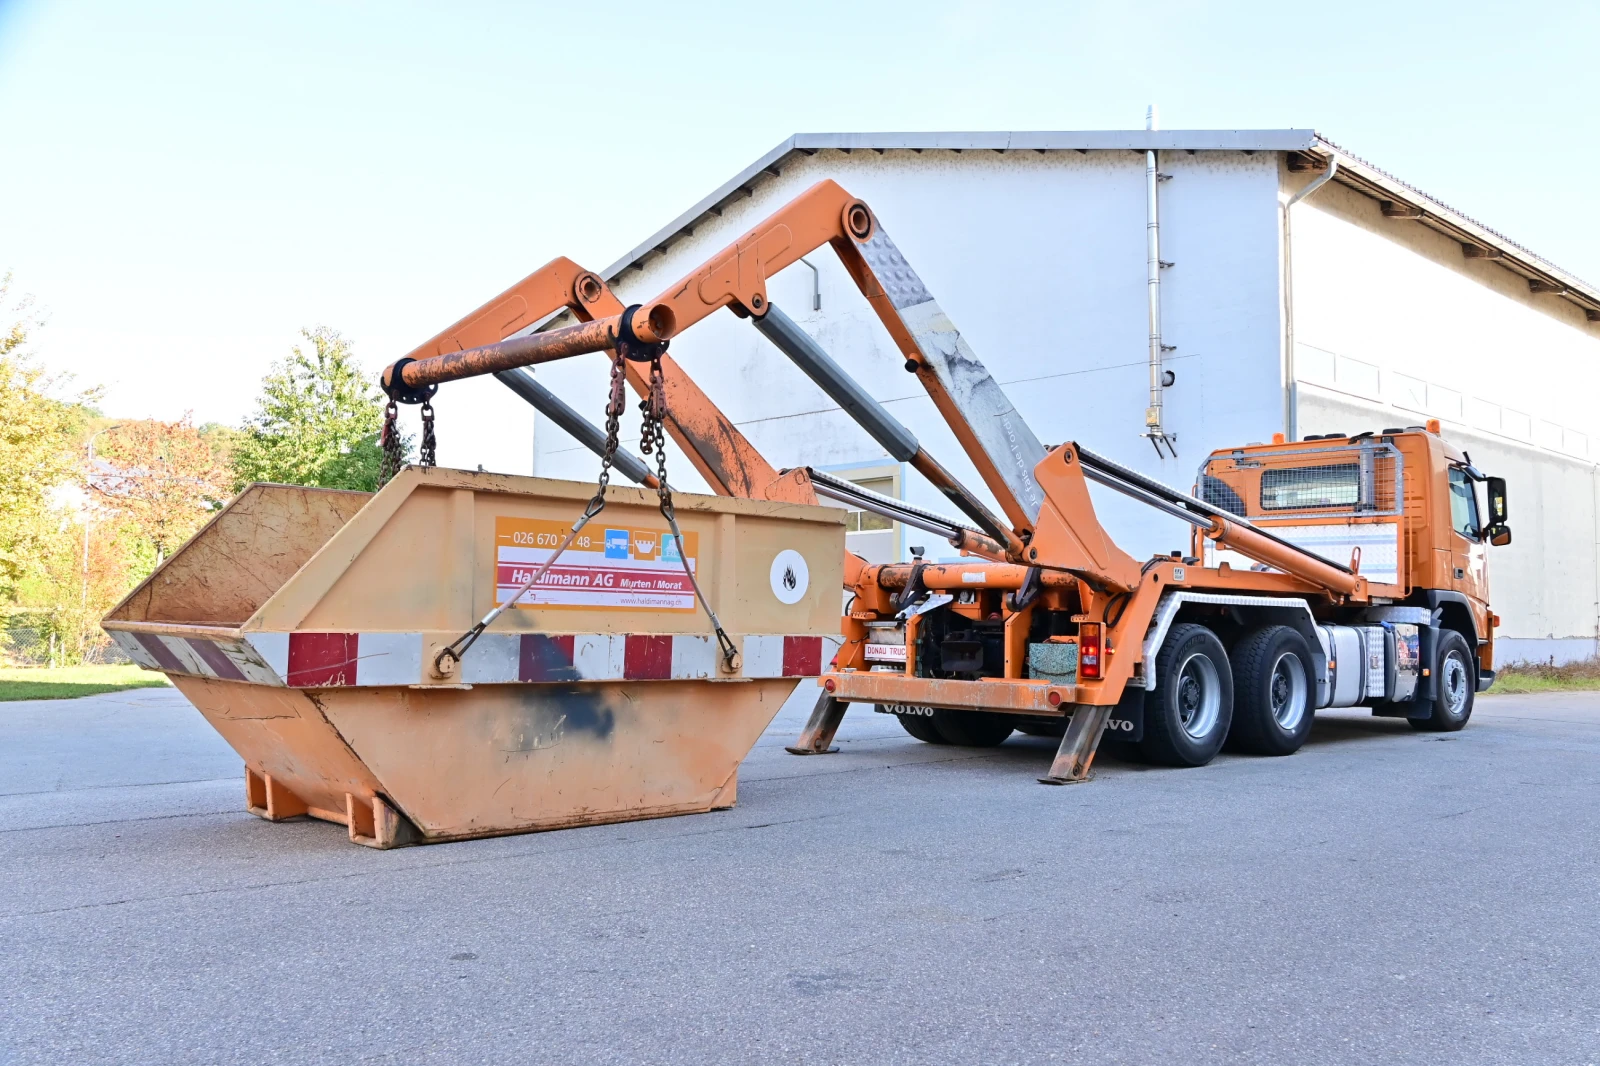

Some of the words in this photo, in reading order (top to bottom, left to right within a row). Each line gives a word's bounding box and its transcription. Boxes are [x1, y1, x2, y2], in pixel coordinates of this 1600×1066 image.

[1015, 451, 1024, 468] de
[1021, 469, 1033, 493] fais
[1029, 493, 1039, 507] Je
[513, 531, 534, 544] 026
[537, 533, 558, 546] 670
[576, 536, 591, 548] 48
[592, 573, 614, 587] AG
[620, 578, 651, 589] Murten
[657, 580, 682, 590] Morat
[620, 598, 682, 607] www.haldimannag.ch
[883, 704, 934, 717] VOLVO
